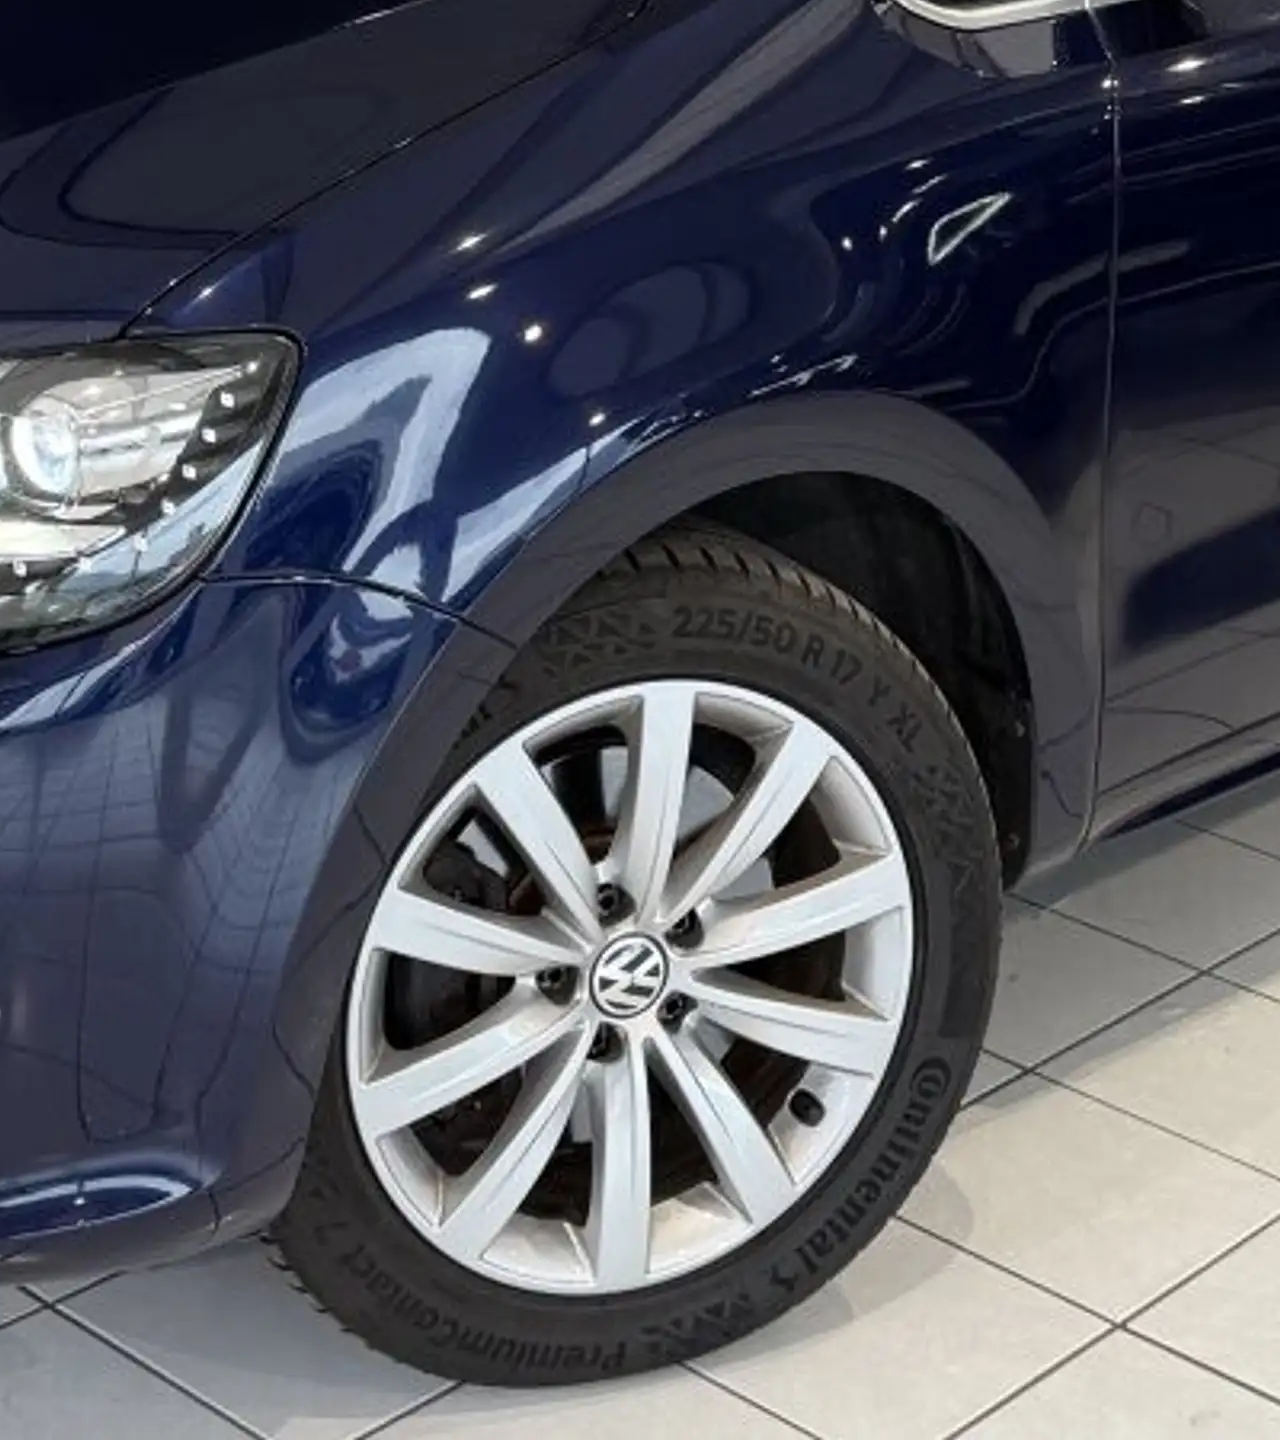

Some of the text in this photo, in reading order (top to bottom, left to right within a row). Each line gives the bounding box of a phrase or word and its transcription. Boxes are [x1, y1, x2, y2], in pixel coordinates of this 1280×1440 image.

[670, 609, 798, 655] 225/50
[800, 633, 825, 669] R
[829, 648, 864, 685] 17
[886, 702, 922, 754] XL
[794, 1056, 951, 1274] Continental
[340, 1244, 626, 1372] PremiumContact
